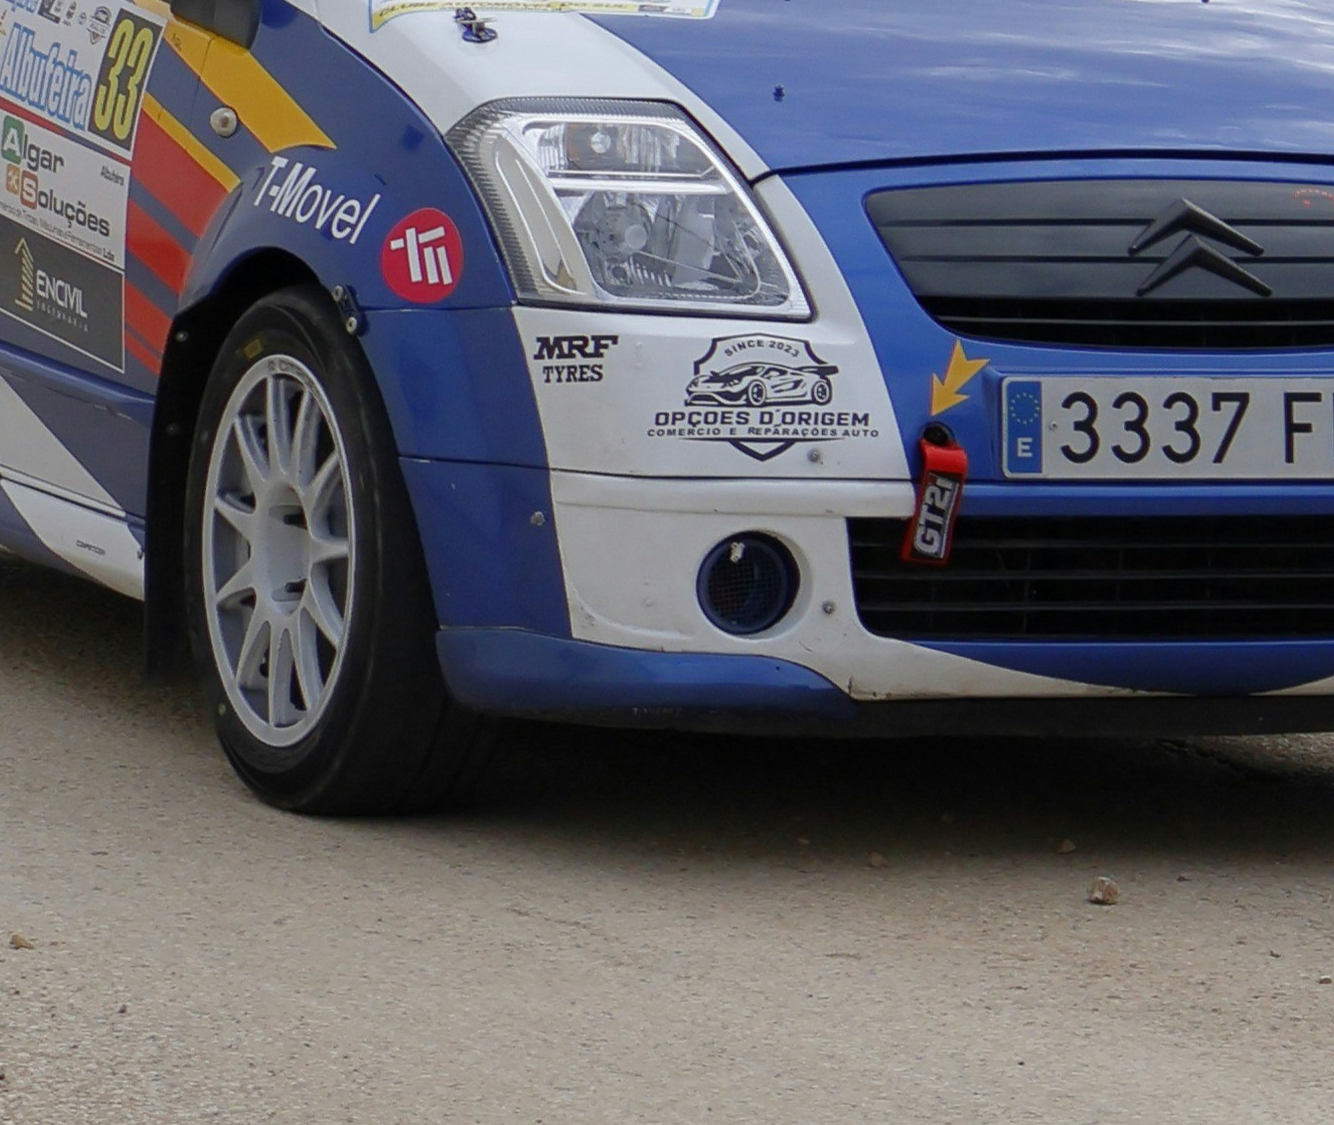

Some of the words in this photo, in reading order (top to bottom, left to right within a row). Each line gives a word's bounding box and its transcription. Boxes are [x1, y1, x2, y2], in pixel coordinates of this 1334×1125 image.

[93, 19, 154, 141] 33
[2, 125, 65, 174] Algar
[20, 173, 111, 237] Soluções
[254, 156, 381, 245] T-Movel
[37, 269, 88, 318] ENCIVIL
[533, 335, 619, 360] MRF
[723, 339, 765, 357] SINCE
[768, 339, 800, 358] 2023
[543, 364, 604, 383] TYRES
[729, 427, 737, 435] E
[842, 429, 879, 438] AUTO
[1017, 437, 1033, 457] E
[1061, 391, 1250, 464] 3337
